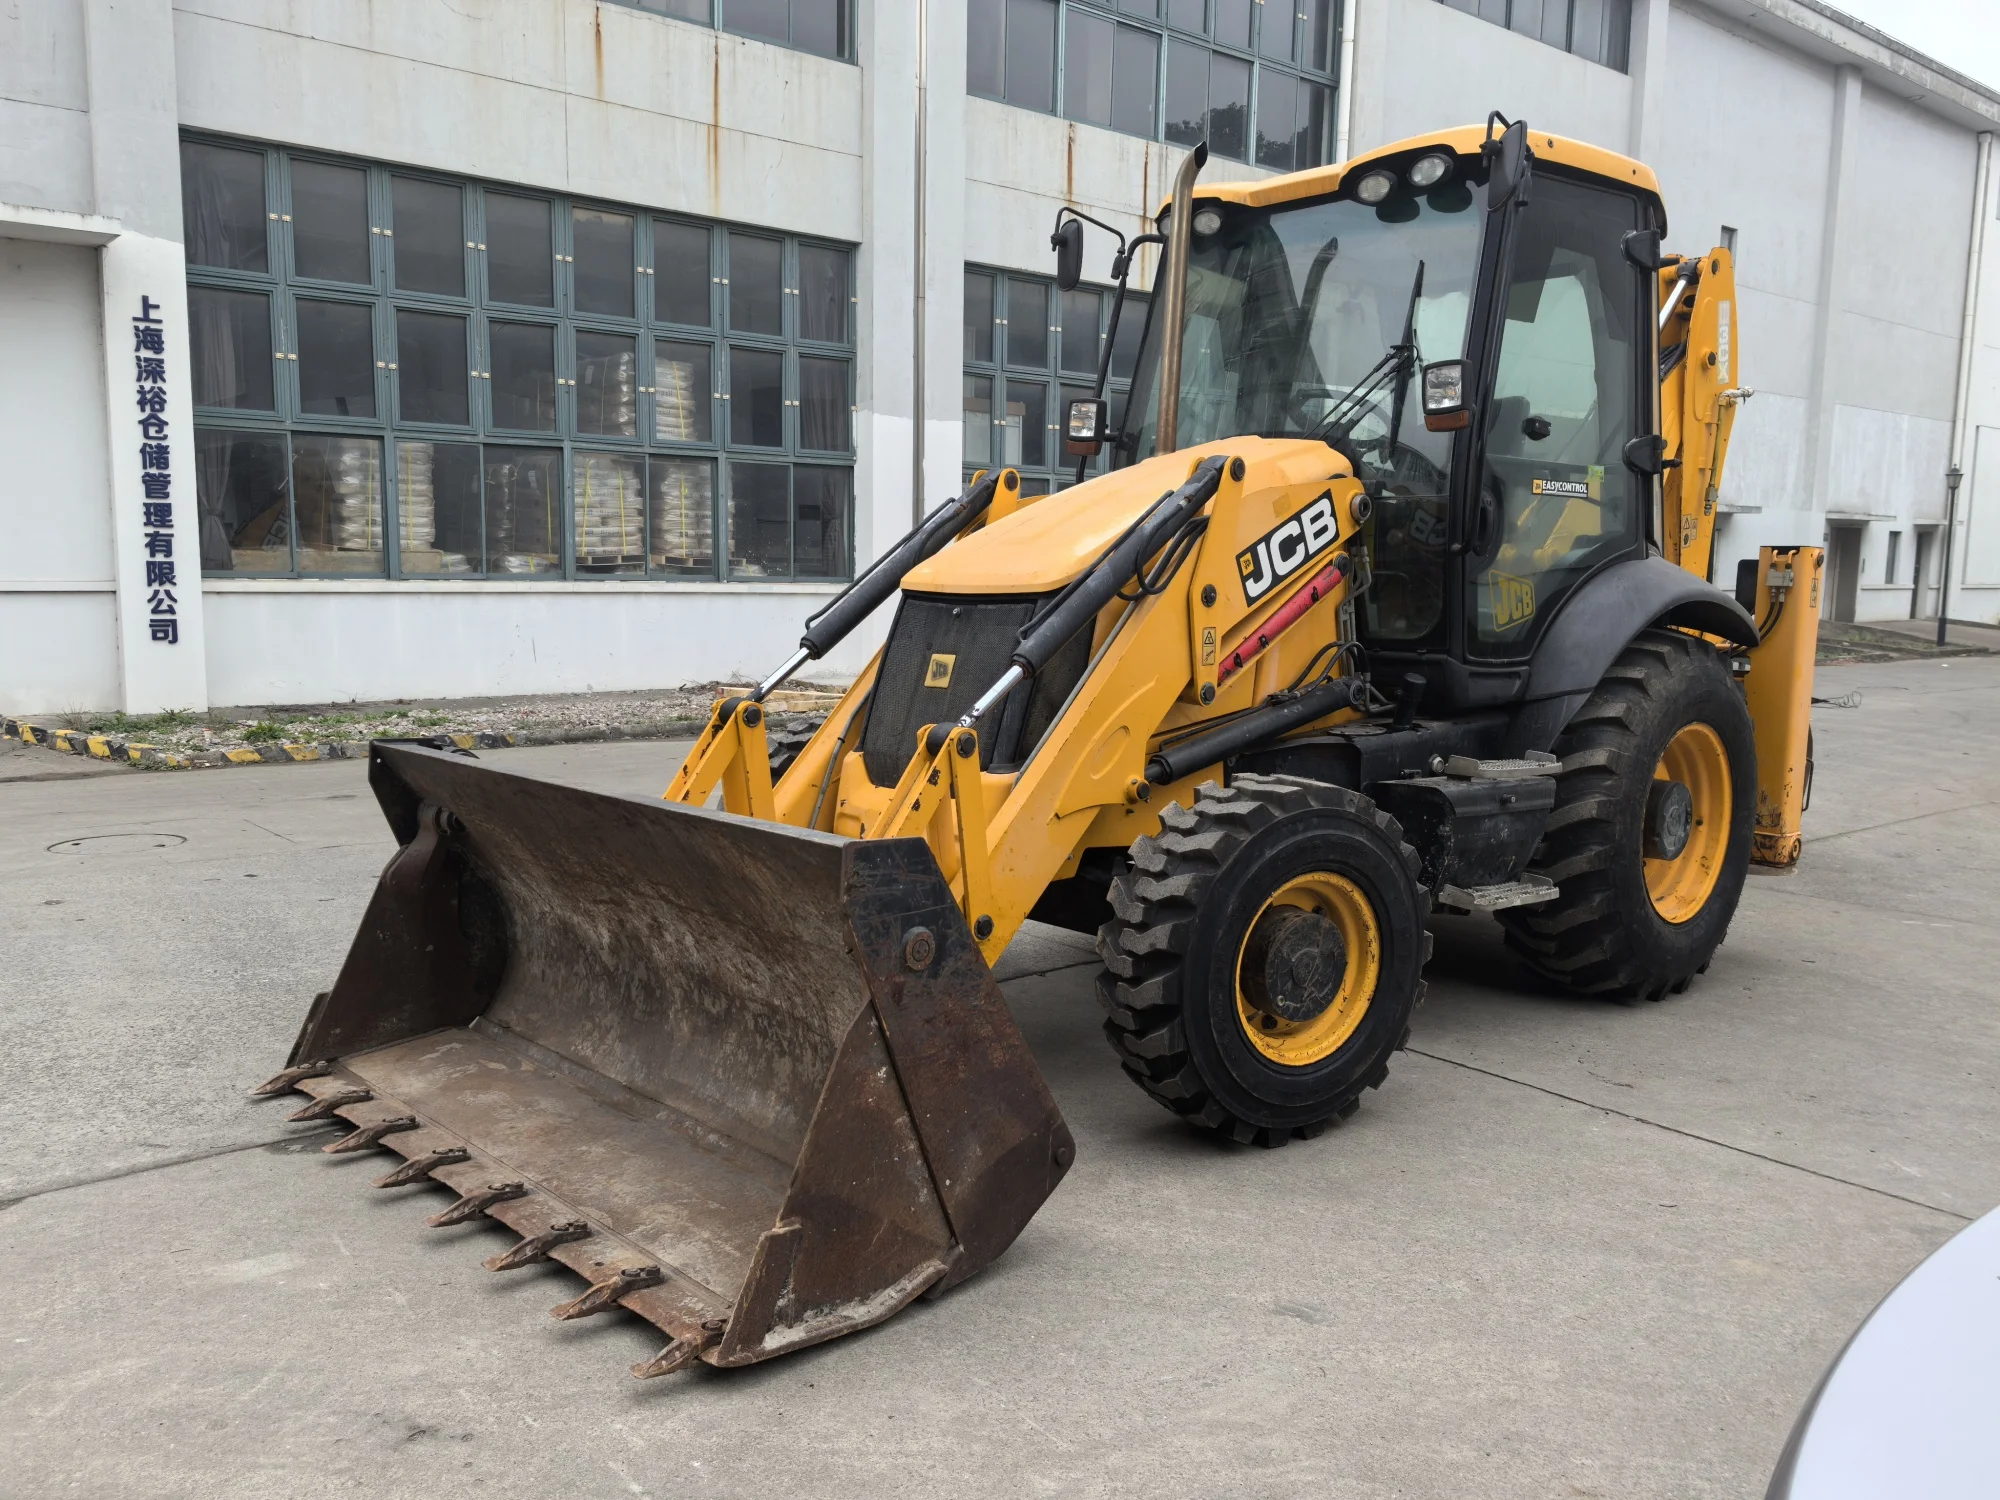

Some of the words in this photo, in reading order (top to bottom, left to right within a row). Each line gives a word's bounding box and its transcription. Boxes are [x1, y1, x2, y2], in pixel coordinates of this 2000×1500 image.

[132, 295, 179, 644] 上海深裕仓储管理有限公司
[1542, 481, 1588, 494] EASYCONTROL
[1245, 498, 1337, 598] JCB
[1496, 579, 1533, 625] JCB
[932, 660, 949, 680] JCB
